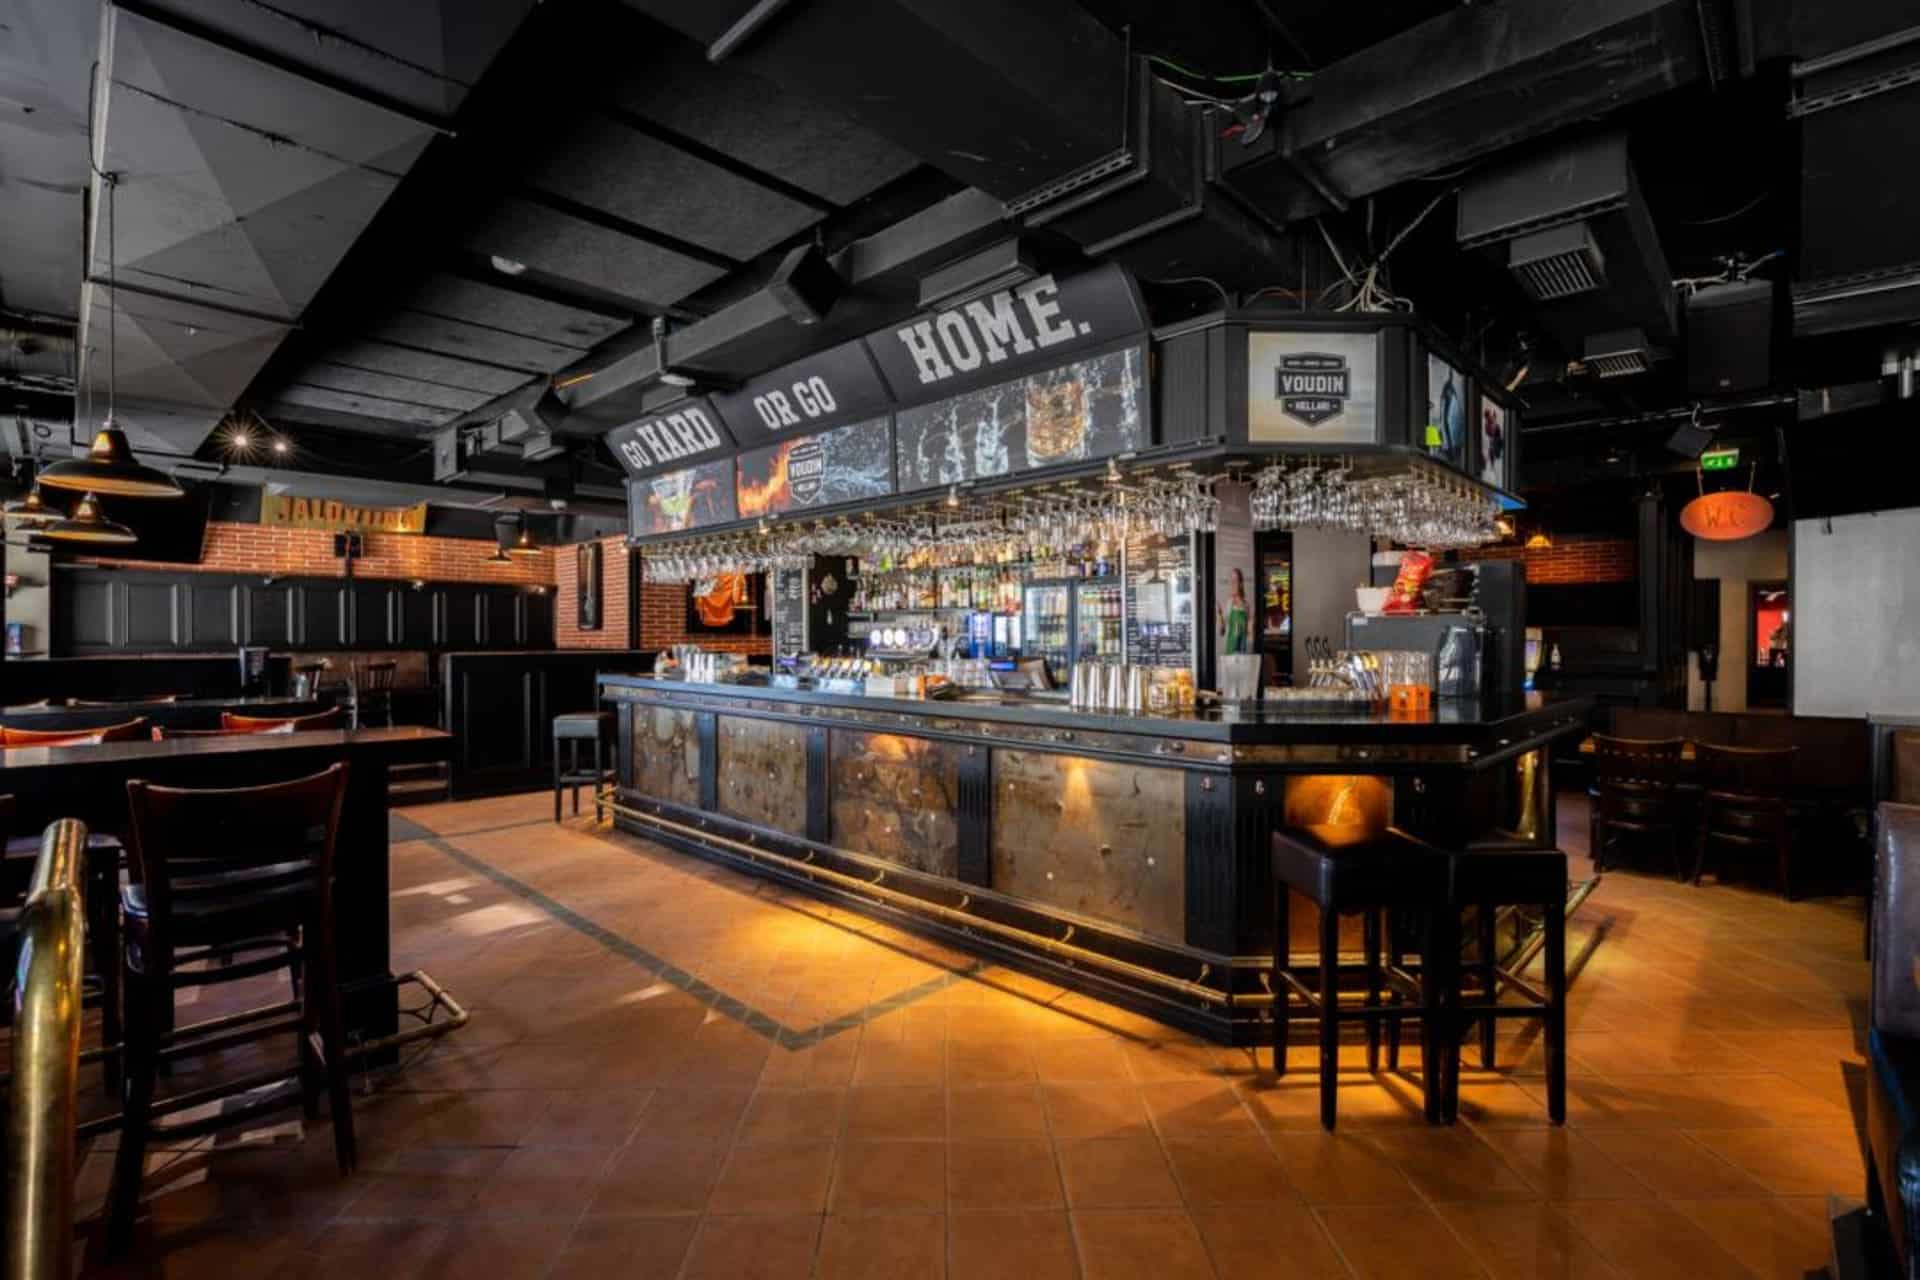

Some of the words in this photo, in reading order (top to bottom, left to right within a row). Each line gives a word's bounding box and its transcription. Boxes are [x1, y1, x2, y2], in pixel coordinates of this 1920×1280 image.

[897, 273, 1092, 385] HOME.
[753, 390, 799, 430] OR
[792, 375, 837, 417] GO
[1282, 375, 1344, 393] VOUDIN
[620, 439, 652, 469] GO
[636, 407, 721, 463] HARD
